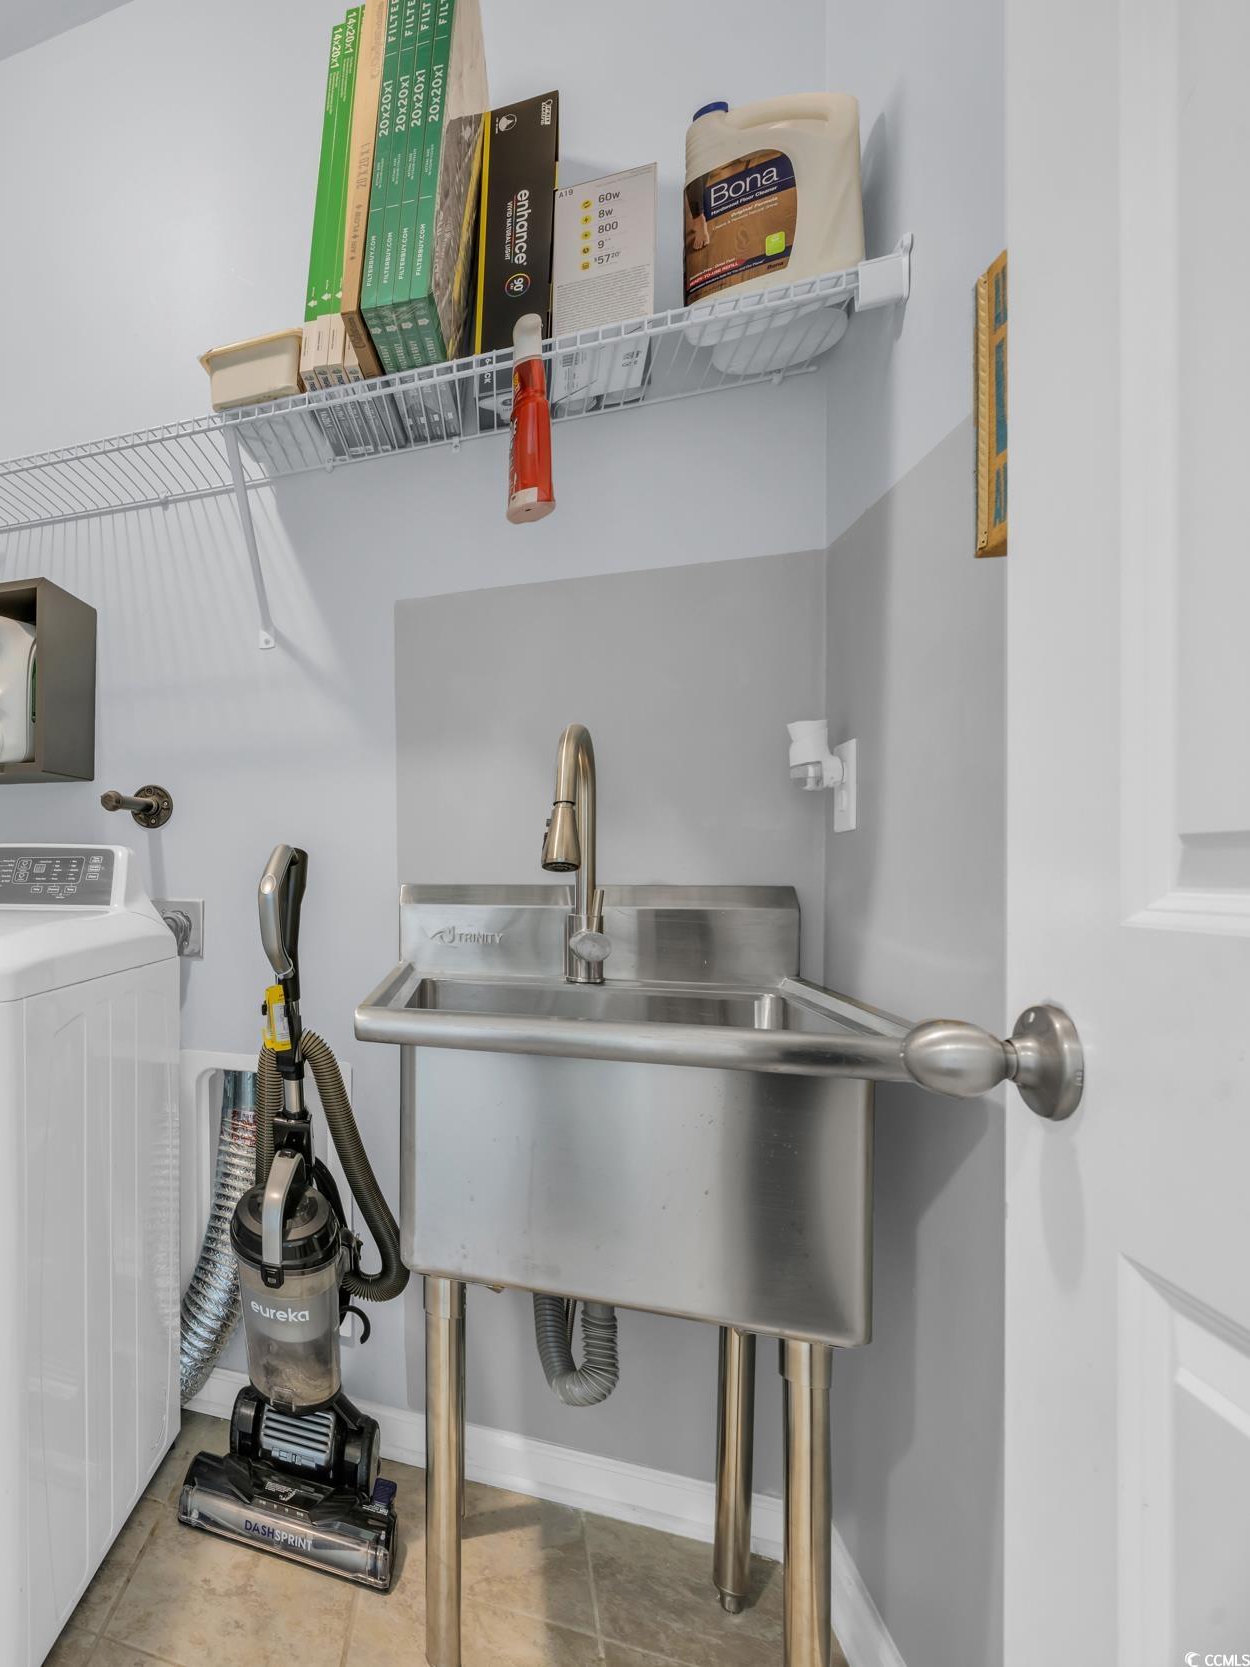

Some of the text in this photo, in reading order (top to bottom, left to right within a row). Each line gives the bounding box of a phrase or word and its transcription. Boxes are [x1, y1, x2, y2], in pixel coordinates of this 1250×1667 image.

[330, 27, 343, 69] 14x20x1
[345, 11, 357, 54] 14x20x1
[379, 79, 393, 137] 20x20x1
[395, 74, 410, 132] 20x20x1
[411, 69, 426, 127] 20x20x1
[429, 64, 444, 122] 20x20x1
[558, 189, 574, 199] A19
[711, 167, 779, 207] Bona
[755, 185, 778, 197] Cleaner
[415, 223, 426, 276] FILTERBUY.COM
[515, 189, 531, 265] enhance
[597, 221, 618, 233] 800
[366, 235, 376, 287] FILTERBUY.COM
[383, 232, 393, 284] FILTERBUY.COM
[398, 227, 408, 280] FILTERBUY.COM
[459, 933, 503, 944] TRINITY
[250, 1300, 310, 1322] eureka
